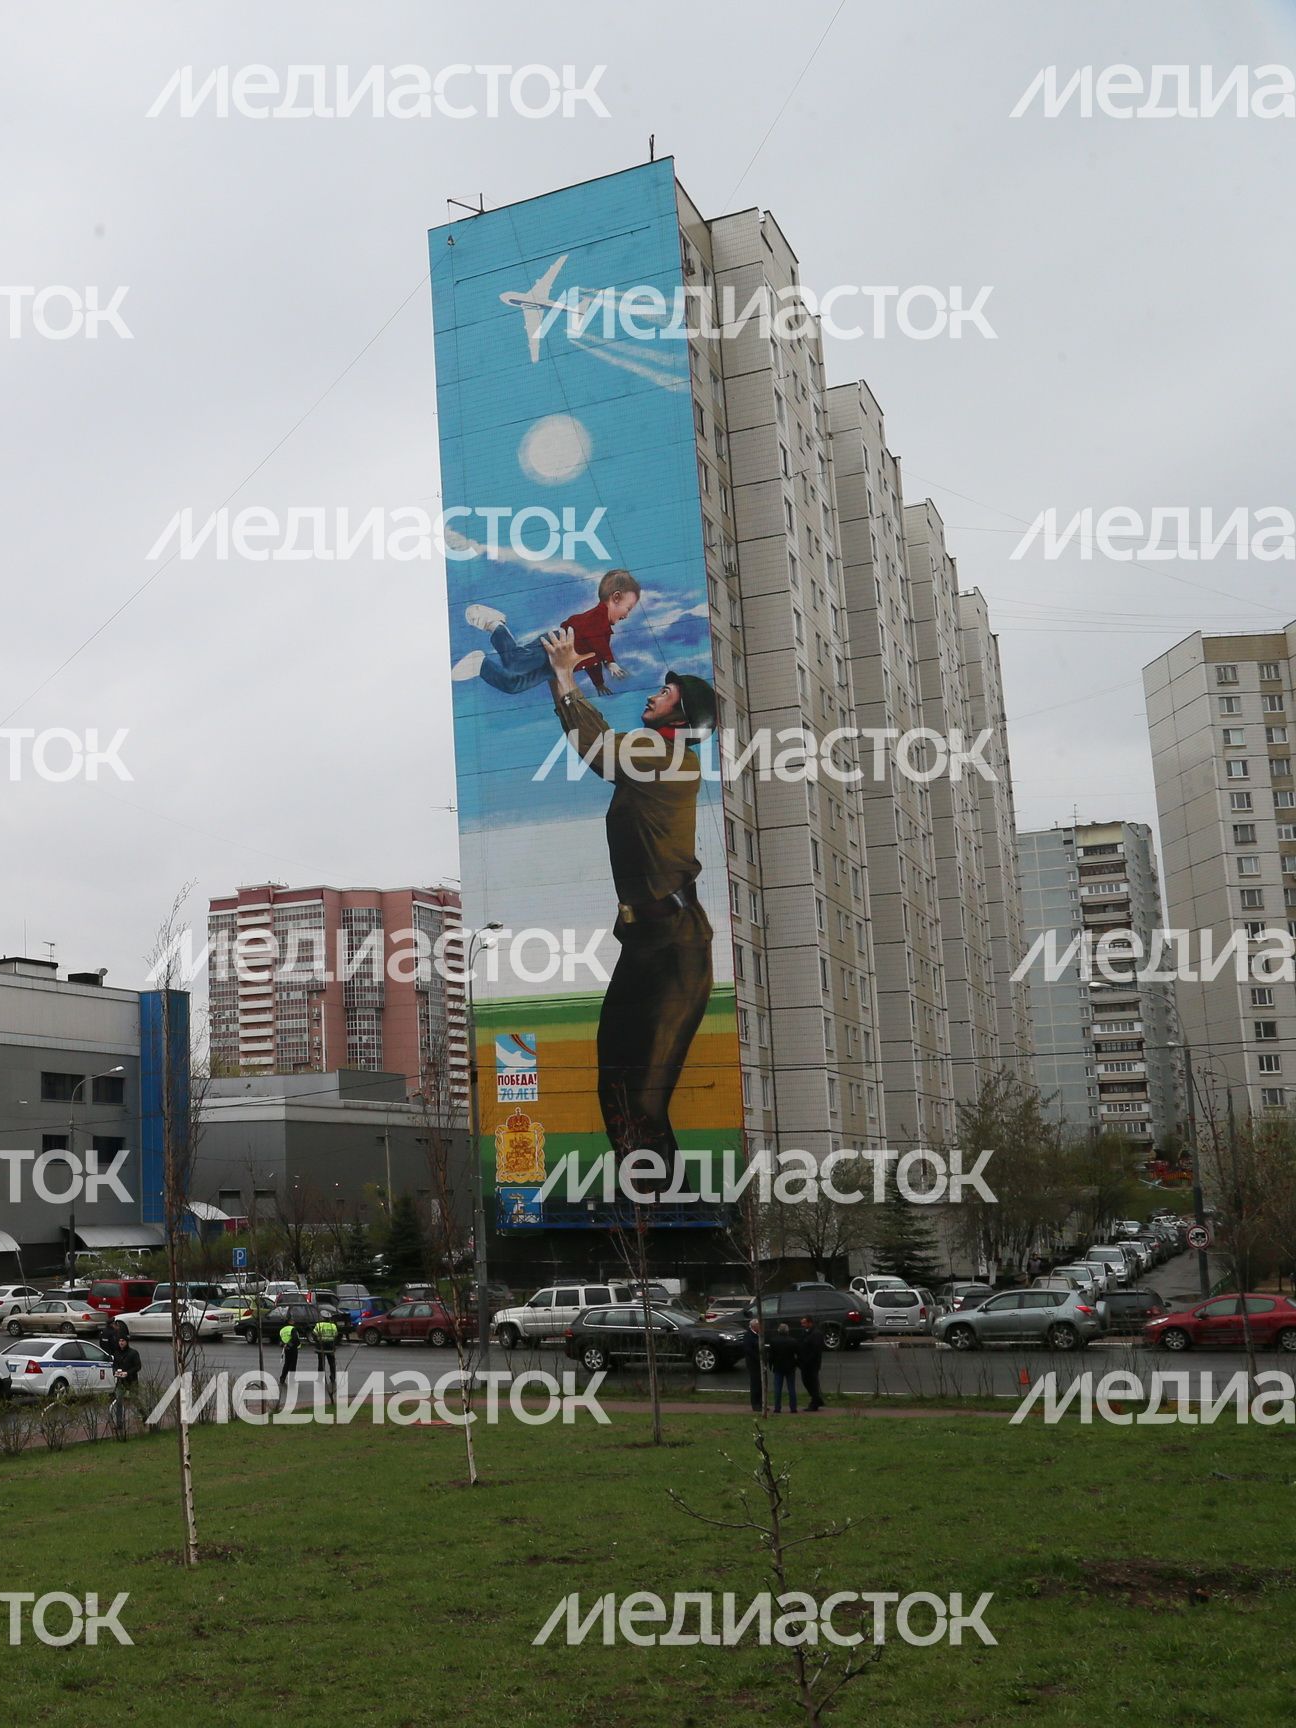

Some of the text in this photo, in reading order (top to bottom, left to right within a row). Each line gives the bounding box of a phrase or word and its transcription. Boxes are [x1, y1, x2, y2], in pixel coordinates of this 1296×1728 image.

[498, 1074, 537, 1086] ПОБЕДА!
[501, 1087, 536, 1100] 70 ЛЕТ
